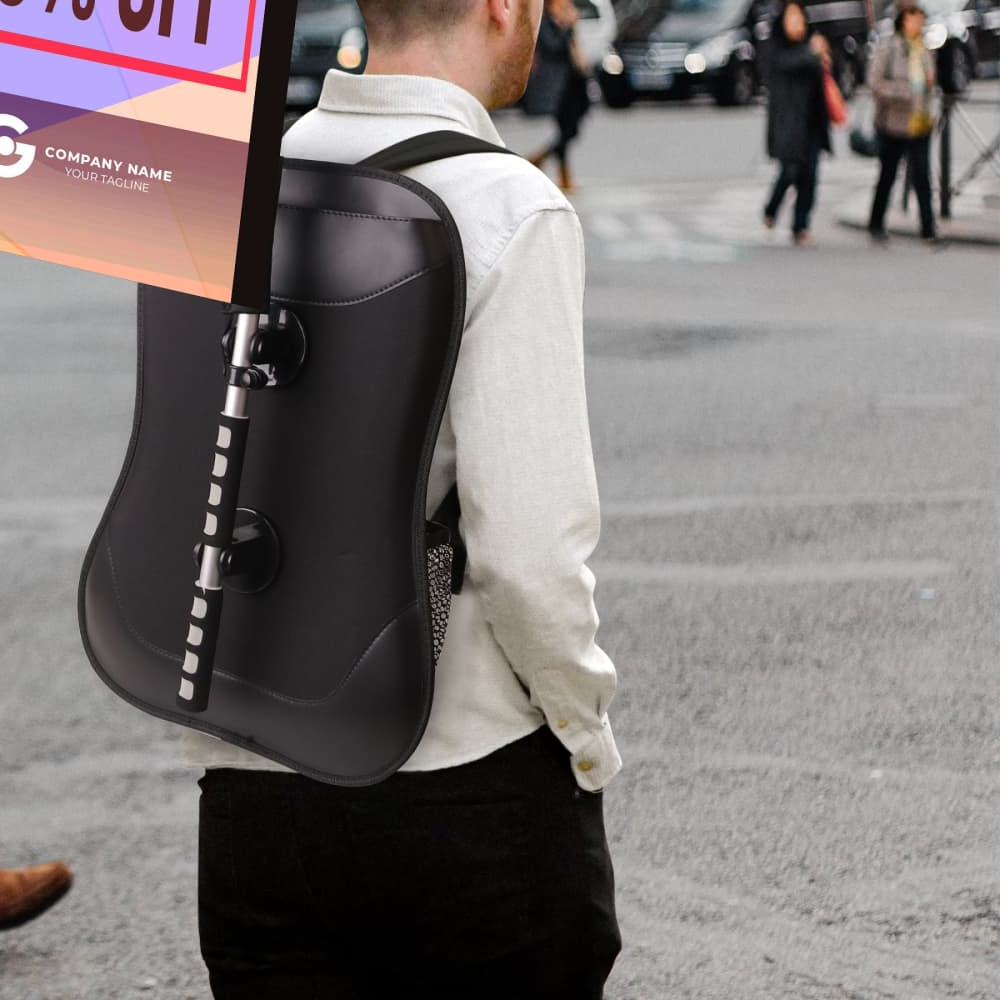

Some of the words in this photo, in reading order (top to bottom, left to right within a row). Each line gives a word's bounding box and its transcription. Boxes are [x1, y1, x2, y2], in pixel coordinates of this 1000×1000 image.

[45, 147, 123, 172] COMPANY
[127, 163, 173, 182] NAME
[65, 167, 98, 183] YOUR
[101, 174, 150, 193] TAGLINE
